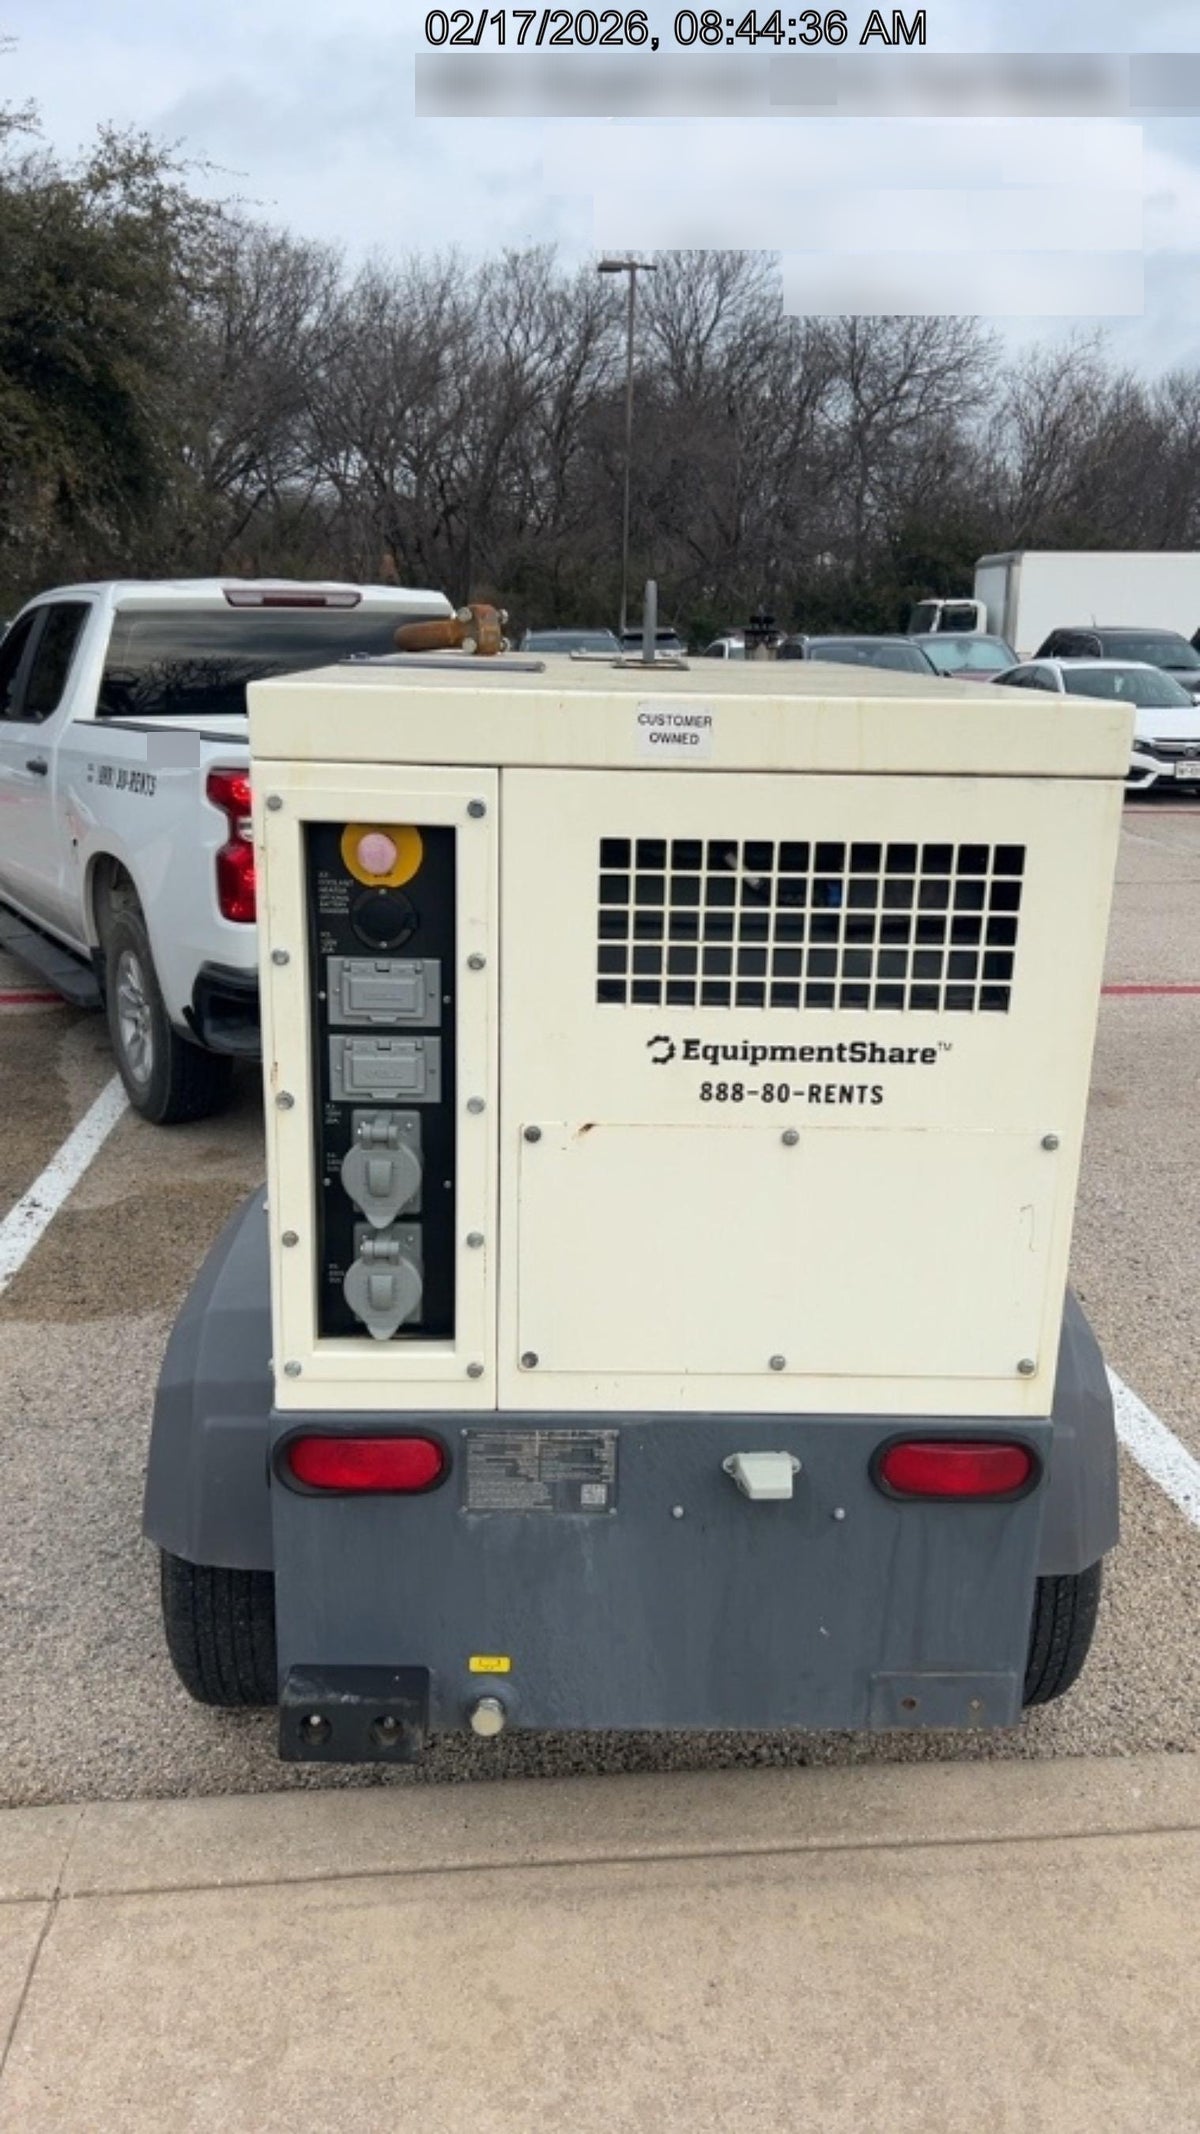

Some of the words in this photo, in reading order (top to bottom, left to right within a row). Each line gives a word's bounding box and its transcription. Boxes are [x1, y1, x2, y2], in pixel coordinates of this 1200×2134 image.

[637, 712, 712, 728] CUSTOMER
[649, 732, 700, 745] OWNED
[699, 1081, 884, 1105] 888-80-RENTS
